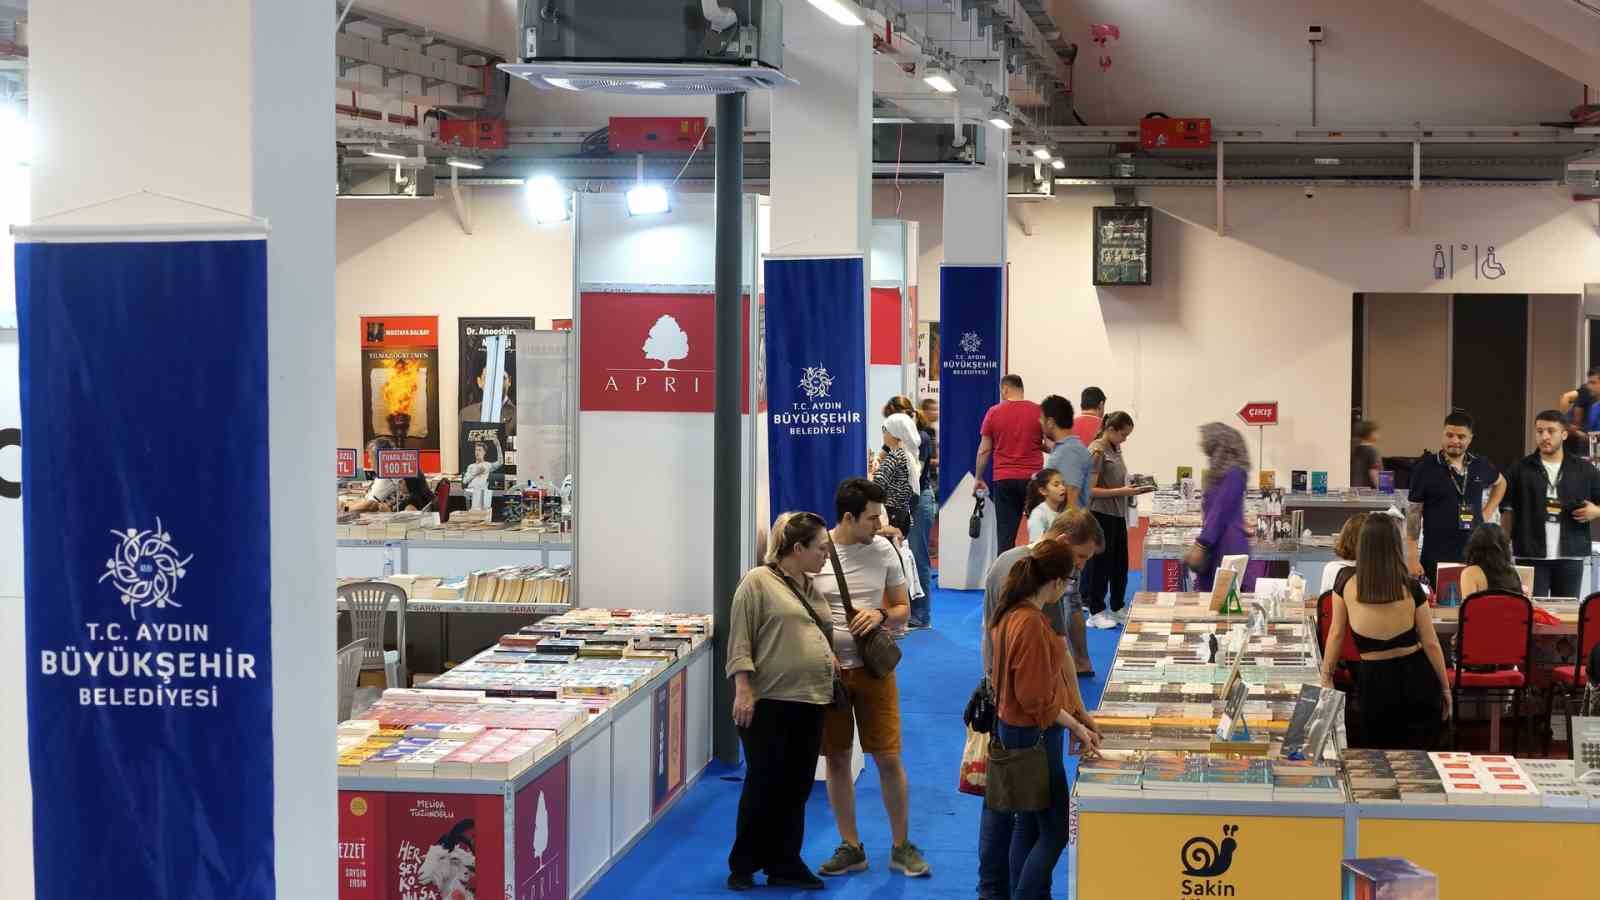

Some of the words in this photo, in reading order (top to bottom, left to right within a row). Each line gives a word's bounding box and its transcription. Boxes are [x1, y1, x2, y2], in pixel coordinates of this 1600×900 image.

[466, 327, 478, 335] Dr.
[943, 359, 997, 370] BÜYÜKŞEHİR
[792, 403, 811, 411] T.C.
[812, 402, 842, 411] AYDIN
[1248, 408, 1273, 417] ÇIKIŞ
[773, 411, 861, 426] BÜYÜKŞEHİR
[789, 425, 846, 435] BELEDİYESİ
[338, 461, 349, 473] TL
[383, 463, 400, 474] 100
[402, 462, 414, 473] TL
[86, 622, 129, 642] T.C.
[136, 622, 209, 642] AYDIN
[40, 645, 257, 684] BÜYÜKŞEHİR
[79, 684, 218, 708] BELEDİYESİ
[1181, 879, 1235, 896] Sakin
